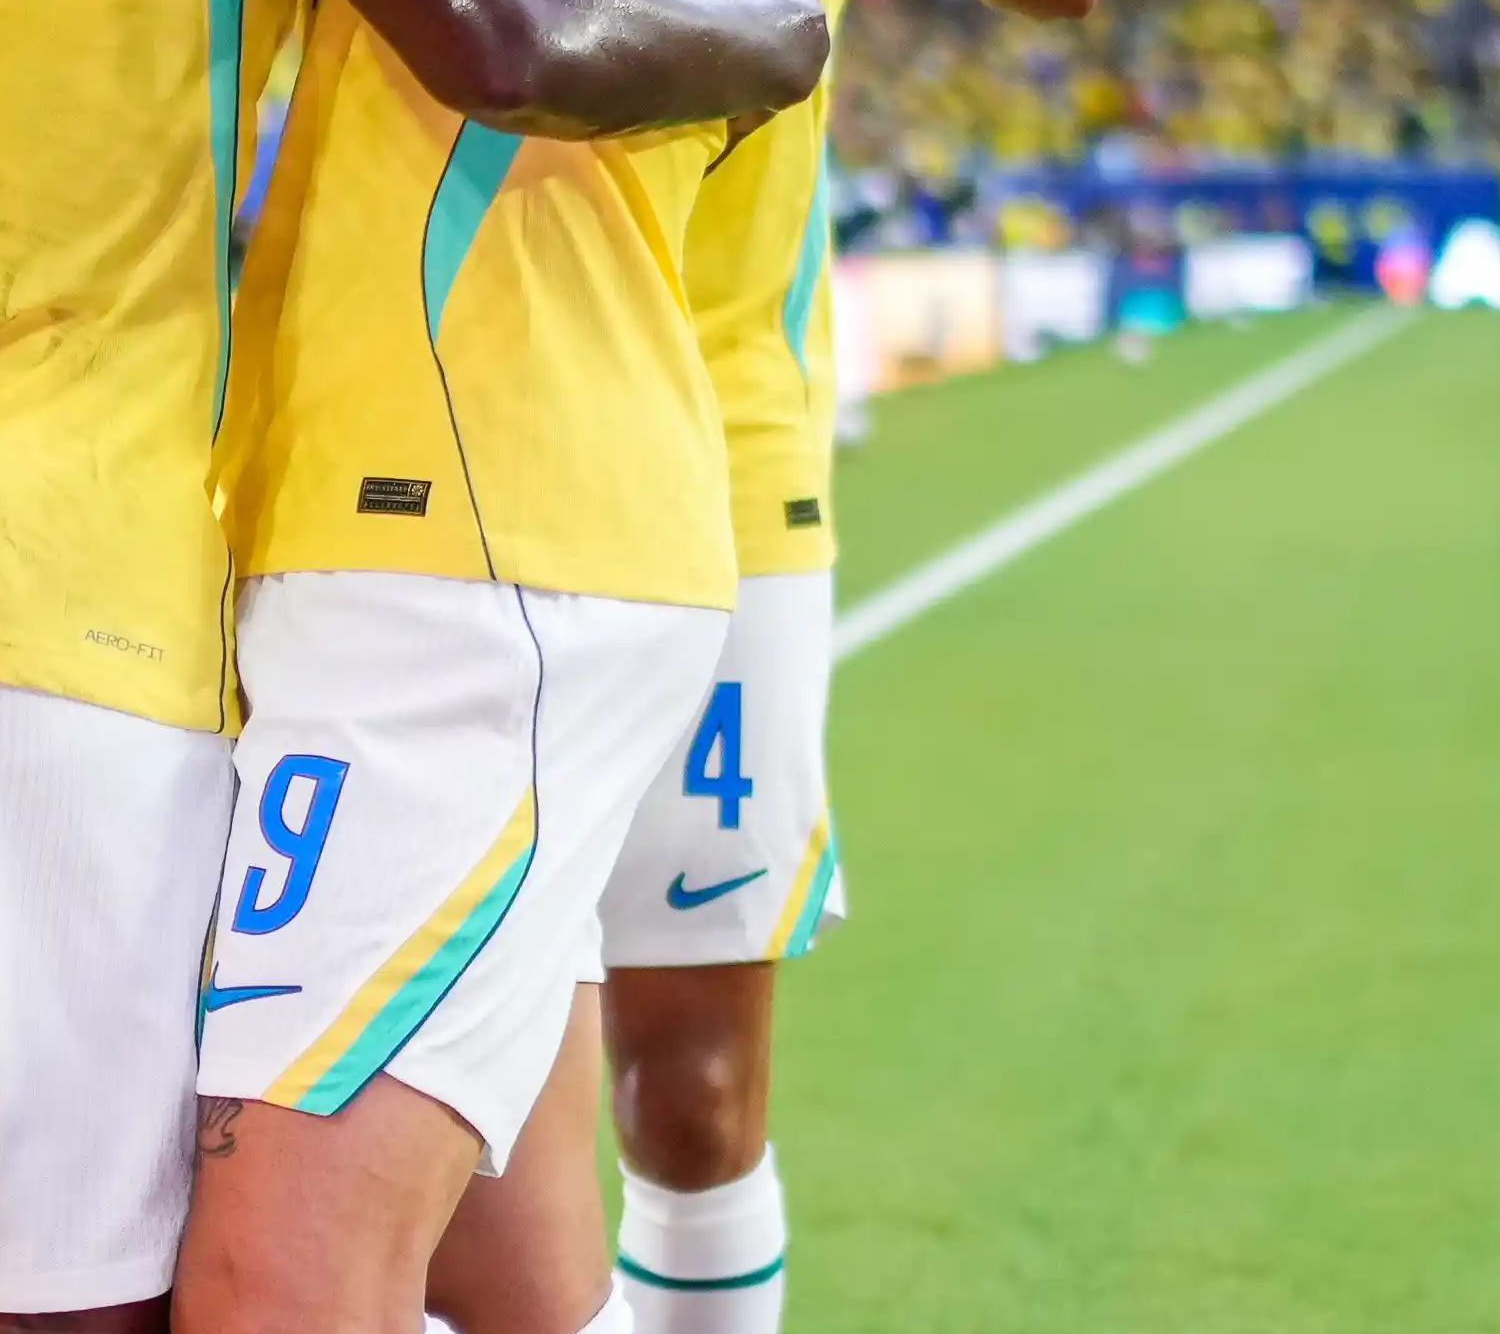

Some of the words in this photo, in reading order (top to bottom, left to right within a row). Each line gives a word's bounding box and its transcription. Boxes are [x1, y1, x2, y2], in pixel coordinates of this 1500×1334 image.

[85, 628, 165, 664] AERO-FIT
[682, 680, 753, 831] 4
[231, 753, 350, 936] 9
